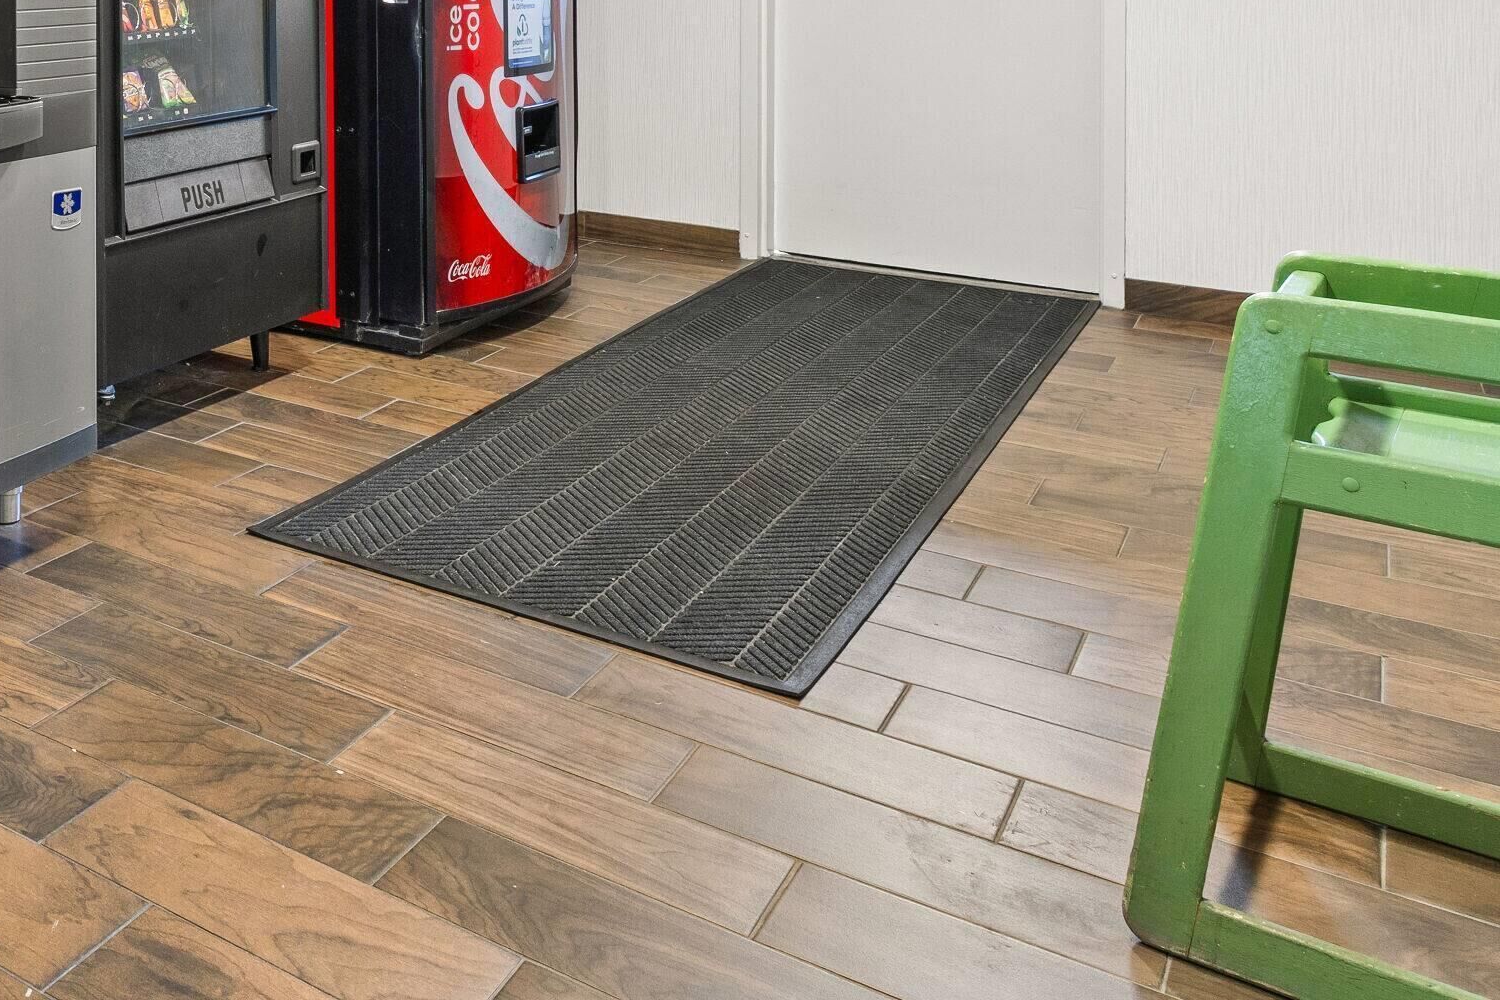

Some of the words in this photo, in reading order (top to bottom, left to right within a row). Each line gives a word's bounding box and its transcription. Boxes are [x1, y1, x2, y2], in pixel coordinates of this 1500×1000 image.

[446, 5, 463, 52] ice
[180, 179, 225, 213] PUSH
[448, 253, 492, 282] Coca-Cola
